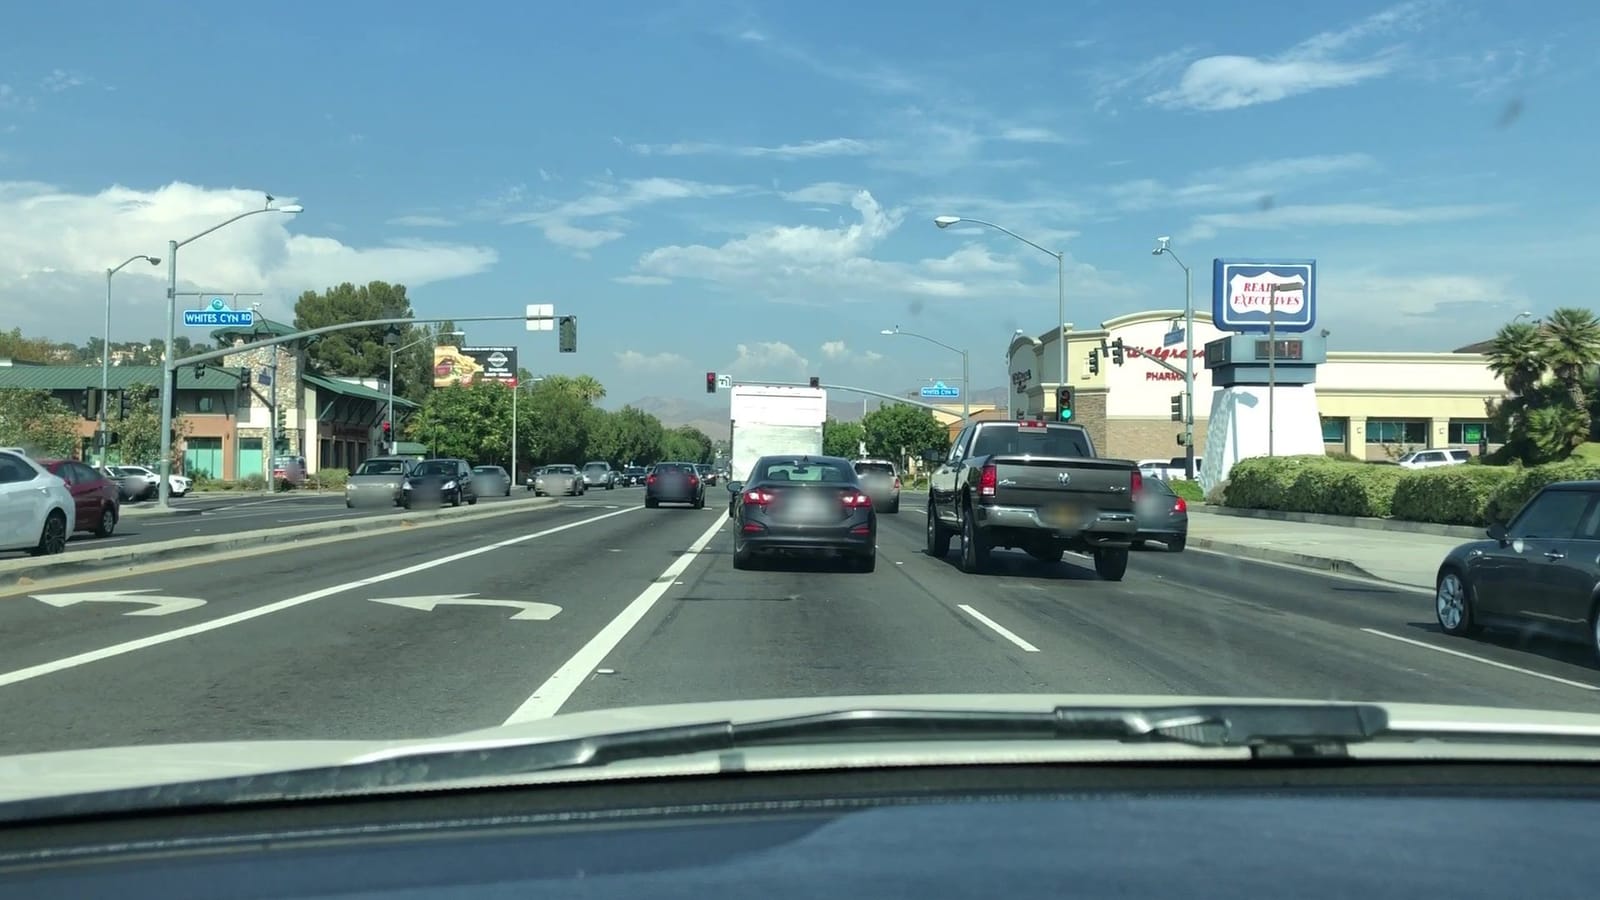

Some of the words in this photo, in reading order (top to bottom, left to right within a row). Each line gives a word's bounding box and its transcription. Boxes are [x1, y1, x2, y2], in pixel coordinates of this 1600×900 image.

[1234, 294, 1300, 307] EXECUIVES
[185, 313, 217, 323] WHITES
[220, 313, 239, 323] CYN
[241, 313, 251, 321] RD
[1145, 372, 1197, 381] PHARMAY
